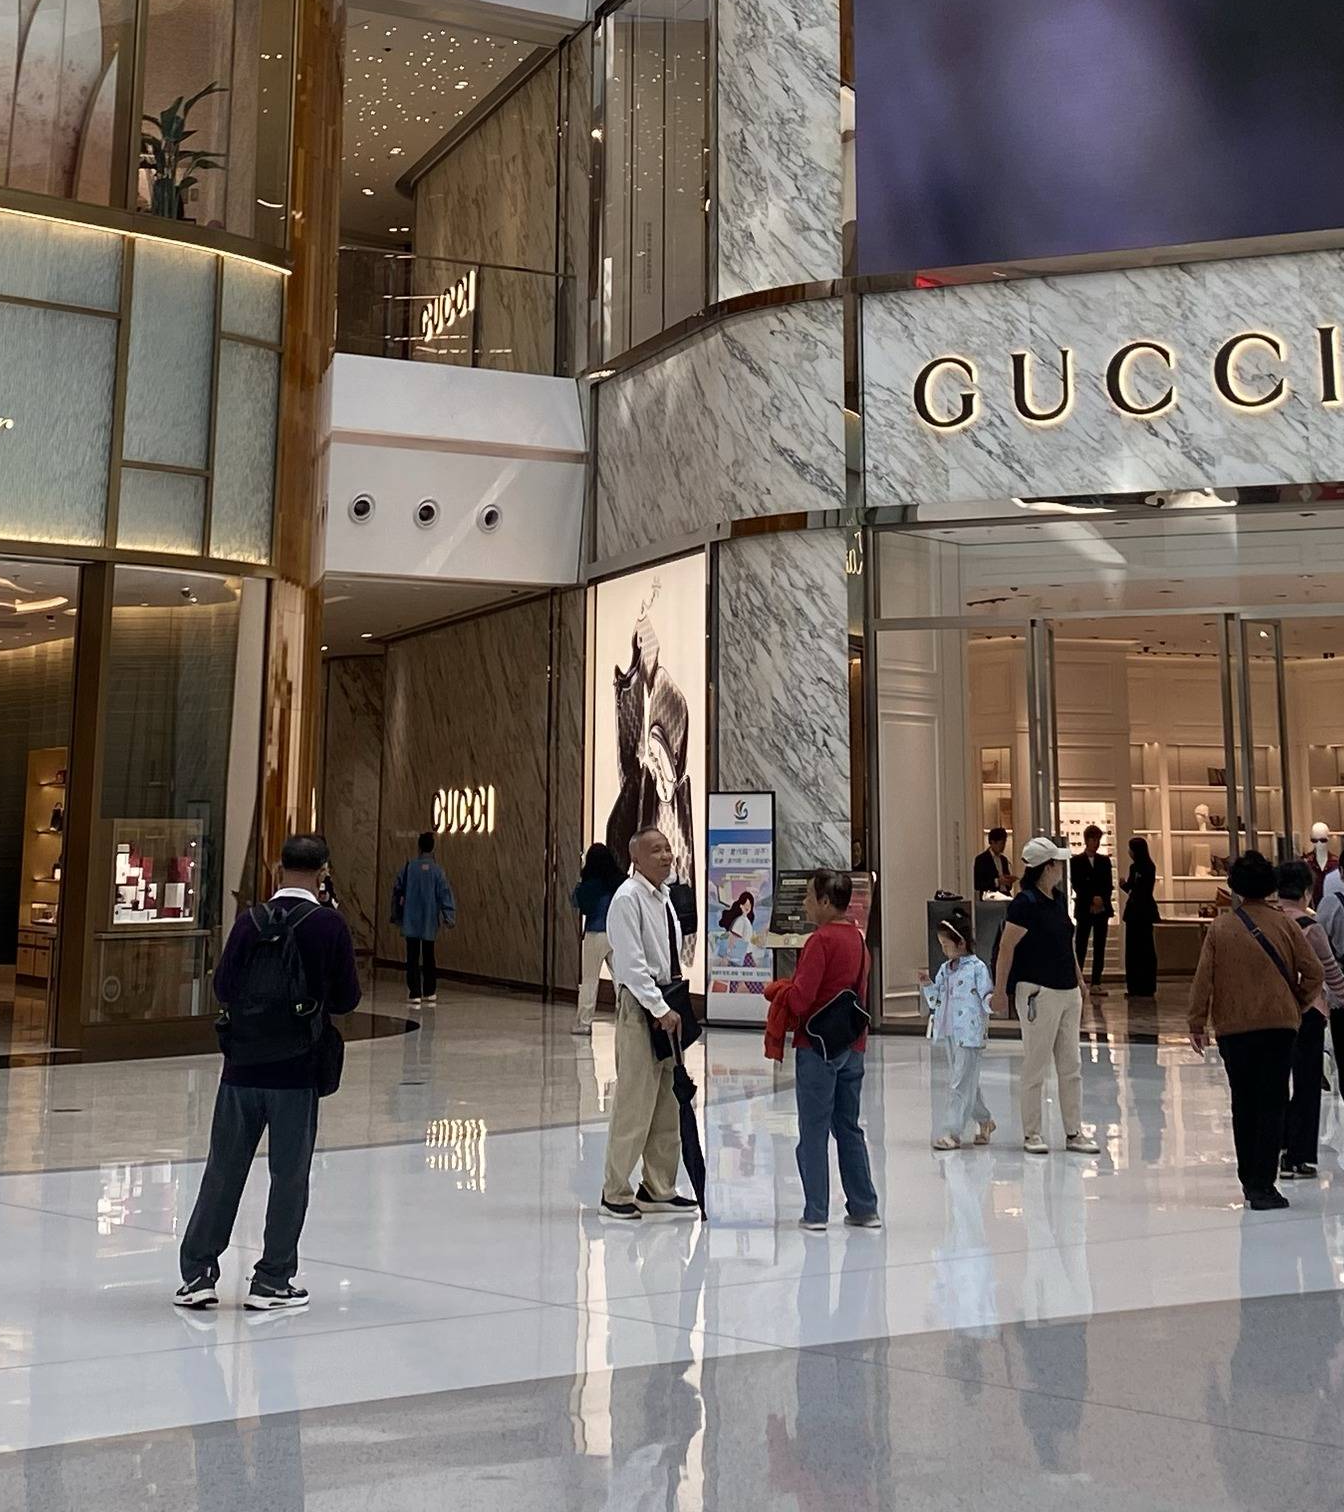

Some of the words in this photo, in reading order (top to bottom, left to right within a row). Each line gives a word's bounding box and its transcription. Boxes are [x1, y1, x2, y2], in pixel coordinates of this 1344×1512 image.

[420, 270, 476, 342] GUCCI
[912, 324, 1343, 430] GUCCI
[431, 784, 496, 835] GUCCI
